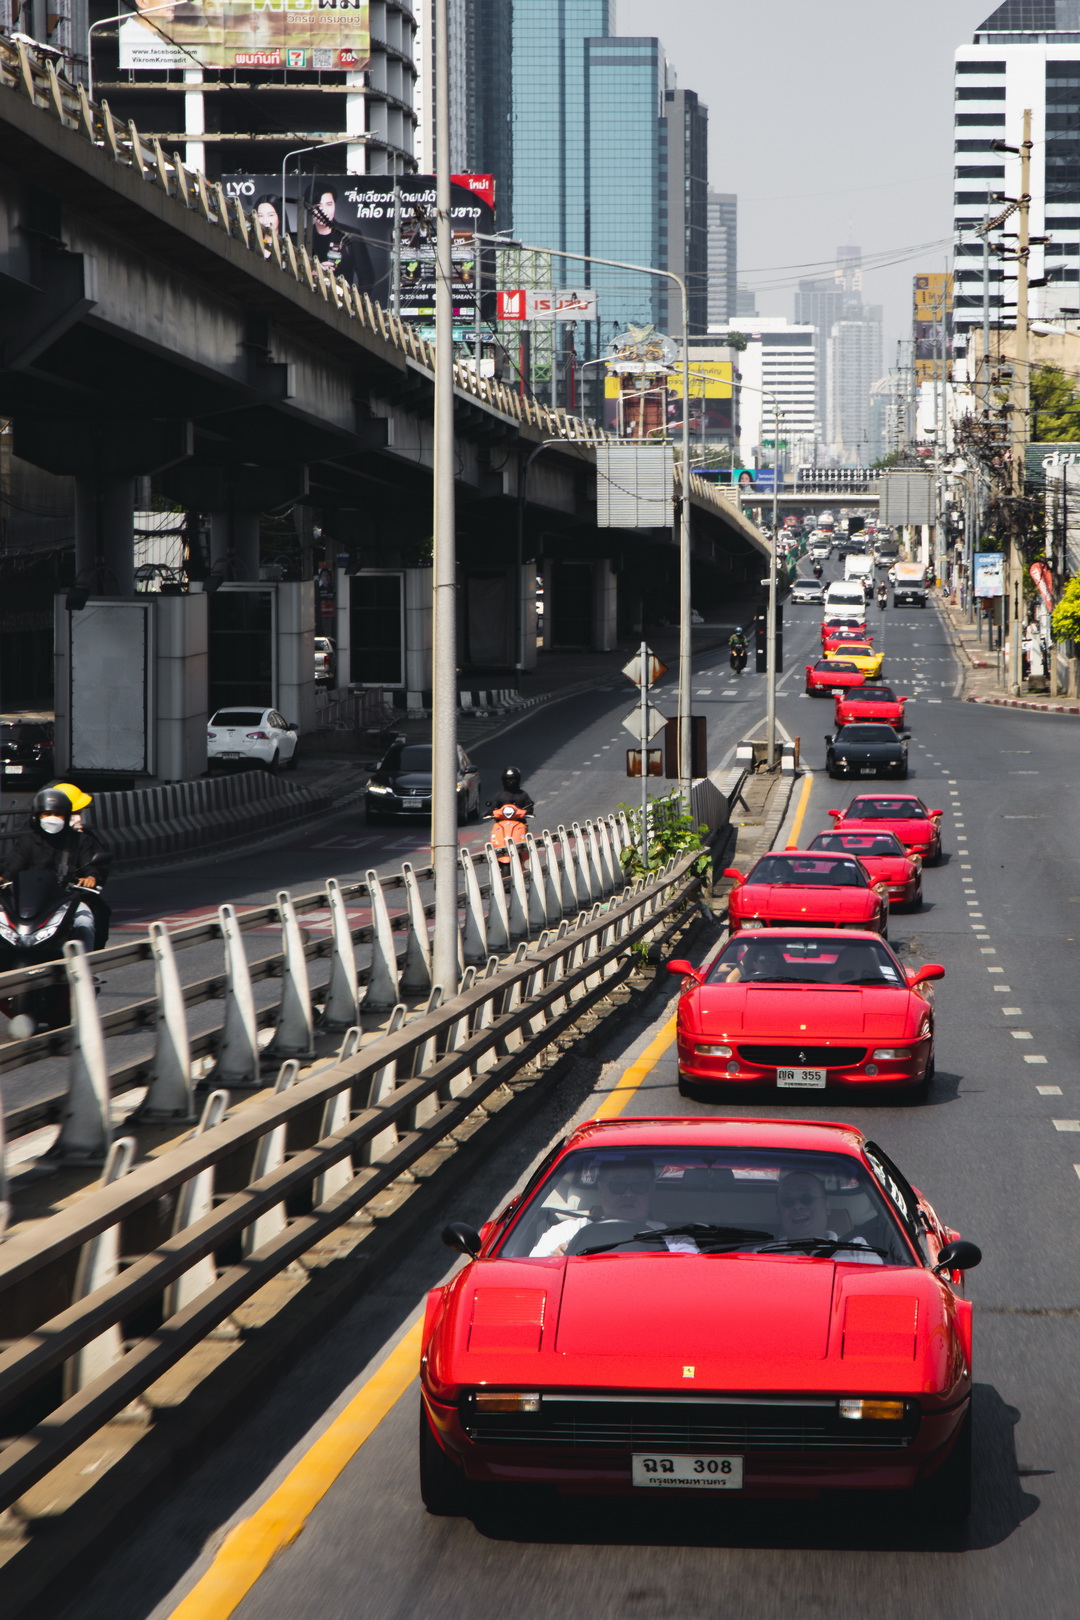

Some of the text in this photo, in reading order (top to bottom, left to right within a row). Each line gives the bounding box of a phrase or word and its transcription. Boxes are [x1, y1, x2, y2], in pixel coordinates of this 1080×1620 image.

[287, 13, 315, 23] วิกรม
[235, 49, 280, 64] พบกันที่
[226, 182, 255, 196] LYO
[468, 179, 489, 190] ใหม่!
[357, 204, 384, 218] ไลโอ
[534, 299, 589, 310] ISUZU
[801, 1071, 821, 1080] 355
[643, 1458, 732, 1474] ฉฉ 308
[648, 1477, 727, 1486] กรุงเทพมหานคร
